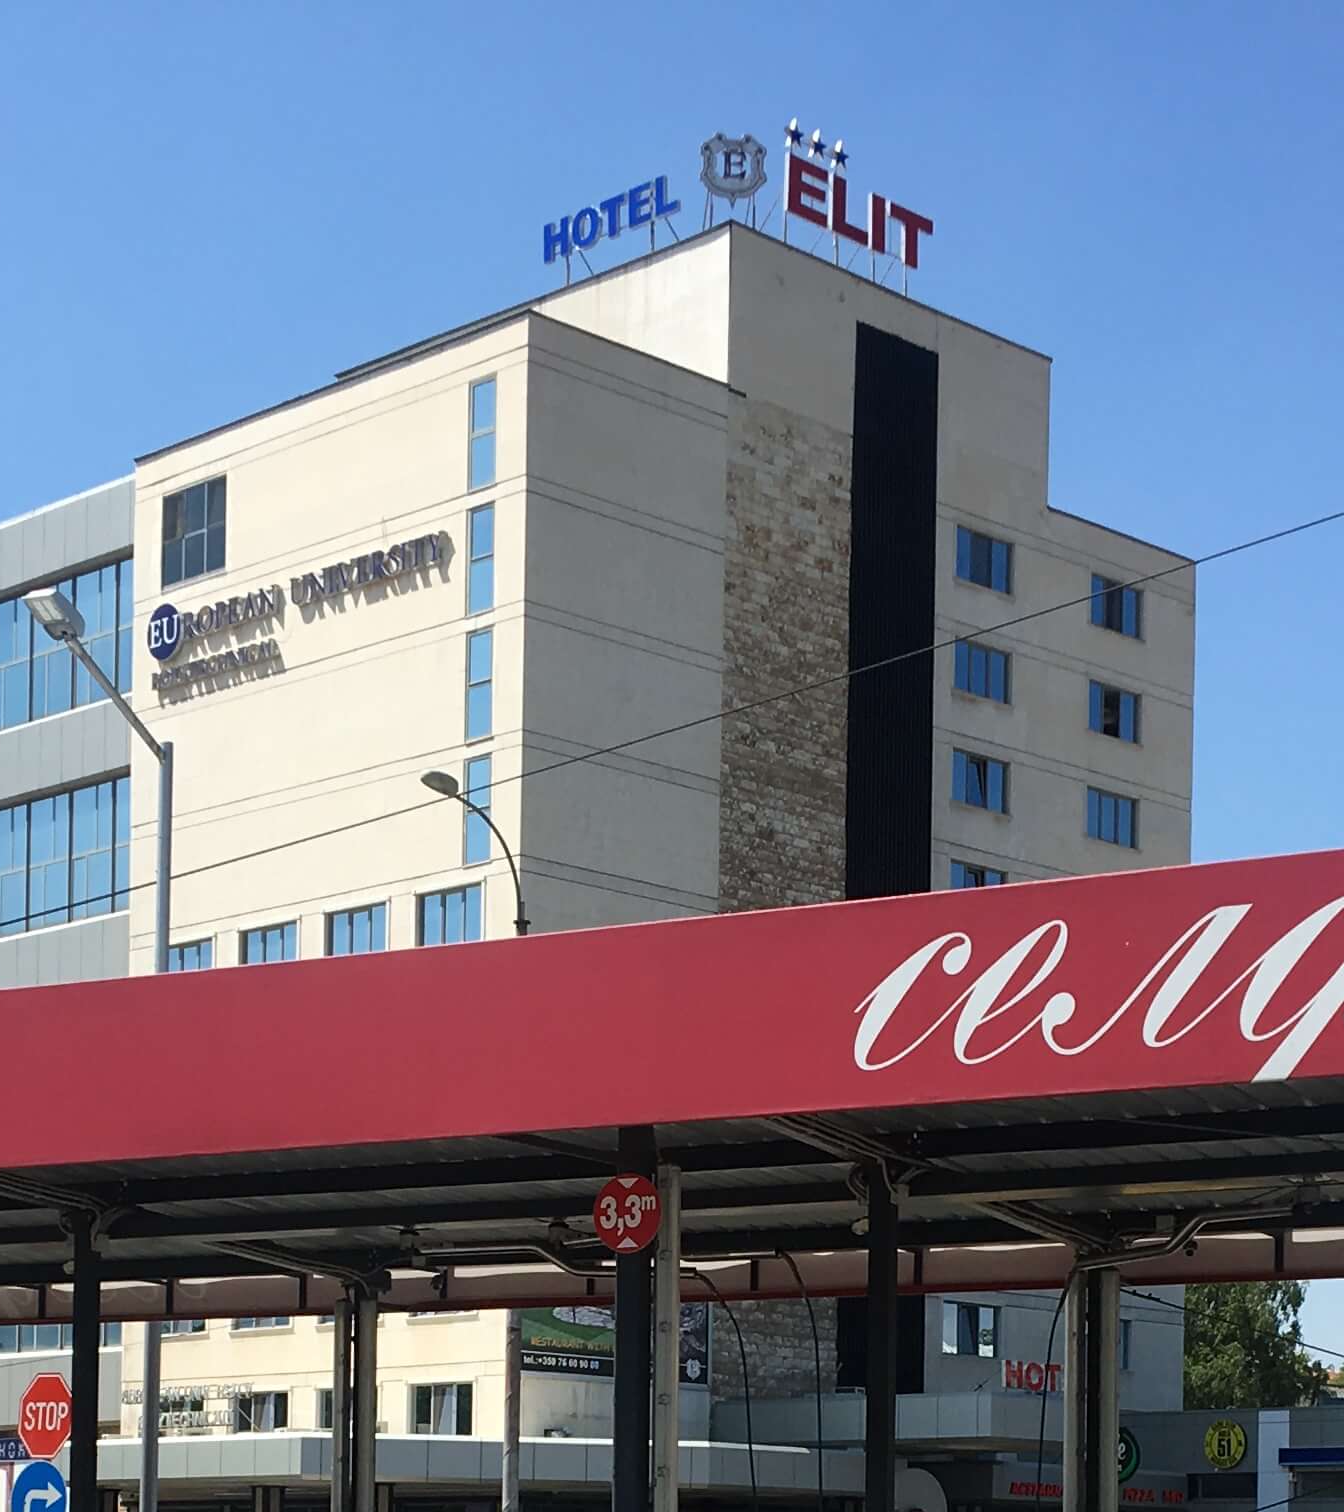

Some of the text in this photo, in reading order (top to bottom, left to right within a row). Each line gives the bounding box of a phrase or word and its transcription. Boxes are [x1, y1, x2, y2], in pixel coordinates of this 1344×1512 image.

[543, 175, 681, 264] HOTEL
[786, 152, 934, 269] ELIT
[290, 532, 446, 605] UNIVERSITY
[1003, 1359, 1063, 1392] HOT
[24, 1401, 69, 1431] STOP
[1217, 1438, 1232, 1457] 51
